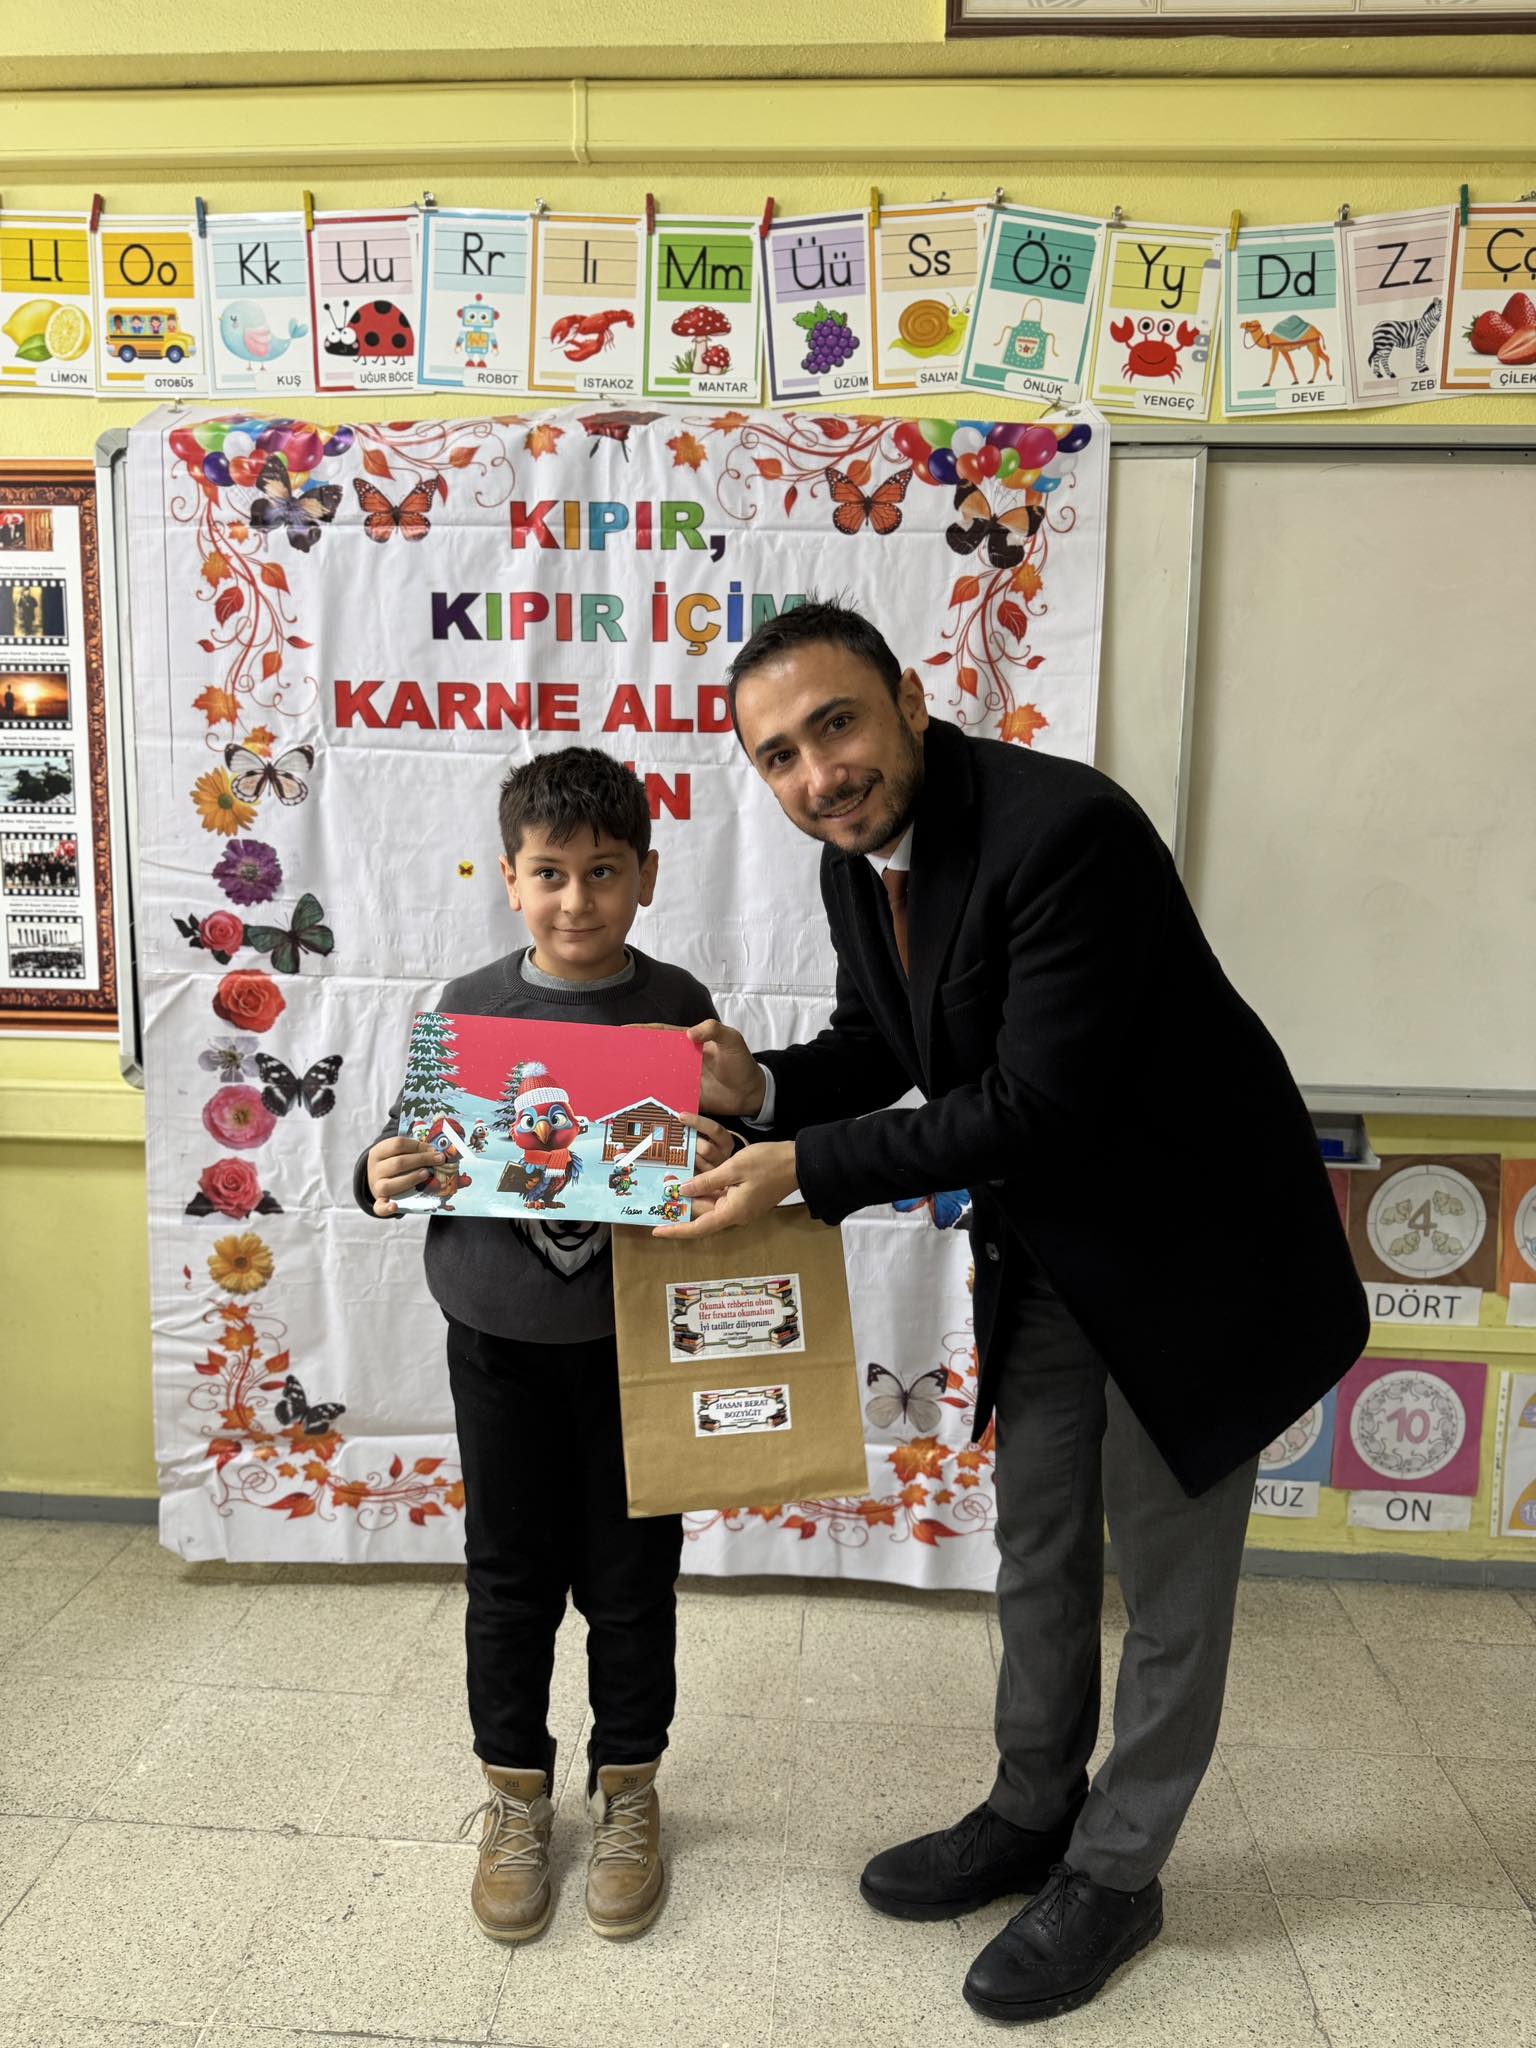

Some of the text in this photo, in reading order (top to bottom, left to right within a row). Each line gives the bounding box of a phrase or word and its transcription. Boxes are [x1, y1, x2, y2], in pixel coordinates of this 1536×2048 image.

[119, 243, 178, 286] Oo
[238, 242, 282, 286] Kk
[337, 240, 396, 283] Uu
[462, 232, 505, 276] Rr
[666, 245, 744, 290] Mm
[791, 236, 852, 290] Üü
[908, 233, 951, 277] Ss
[1013, 230, 1072, 290] Öö
[1377, 242, 1433, 289] Zz
[1138, 244, 1186, 309] Yy
[1257, 252, 1317, 299] Dd
[50, 373, 88, 384] LİMON
[154, 376, 195, 389] OTOBÜS
[277, 375, 302, 388] KUŞ
[360, 371, 414, 384] UĞUR BÖCE
[477, 373, 519, 385] ROBOT
[583, 377, 634, 390] ISTAKOZ
[698, 381, 748, 393] MANTAR
[834, 376, 869, 389] ÜZÜM
[1023, 379, 1063, 395] ÖNLÜK
[1411, 379, 1437, 391] ZEB
[1142, 394, 1195, 410] YENGEÇ
[1291, 391, 1325, 403] DEVE
[510, 500, 726, 563] KIPIR,
[432, 592, 627, 642] KIPIR
[334, 680, 581, 732] KARNE
[1407, 1199, 1438, 1237] 4
[699, 1301, 726, 1311] Okumak
[1375, 1289, 1462, 1319] DÖRT
[716, 1399, 769, 1410] HASAN BERAT
[1387, 1408, 1430, 1444] 10
[1254, 1484, 1304, 1507] KUZ
[1386, 1498, 1431, 1521] ON
